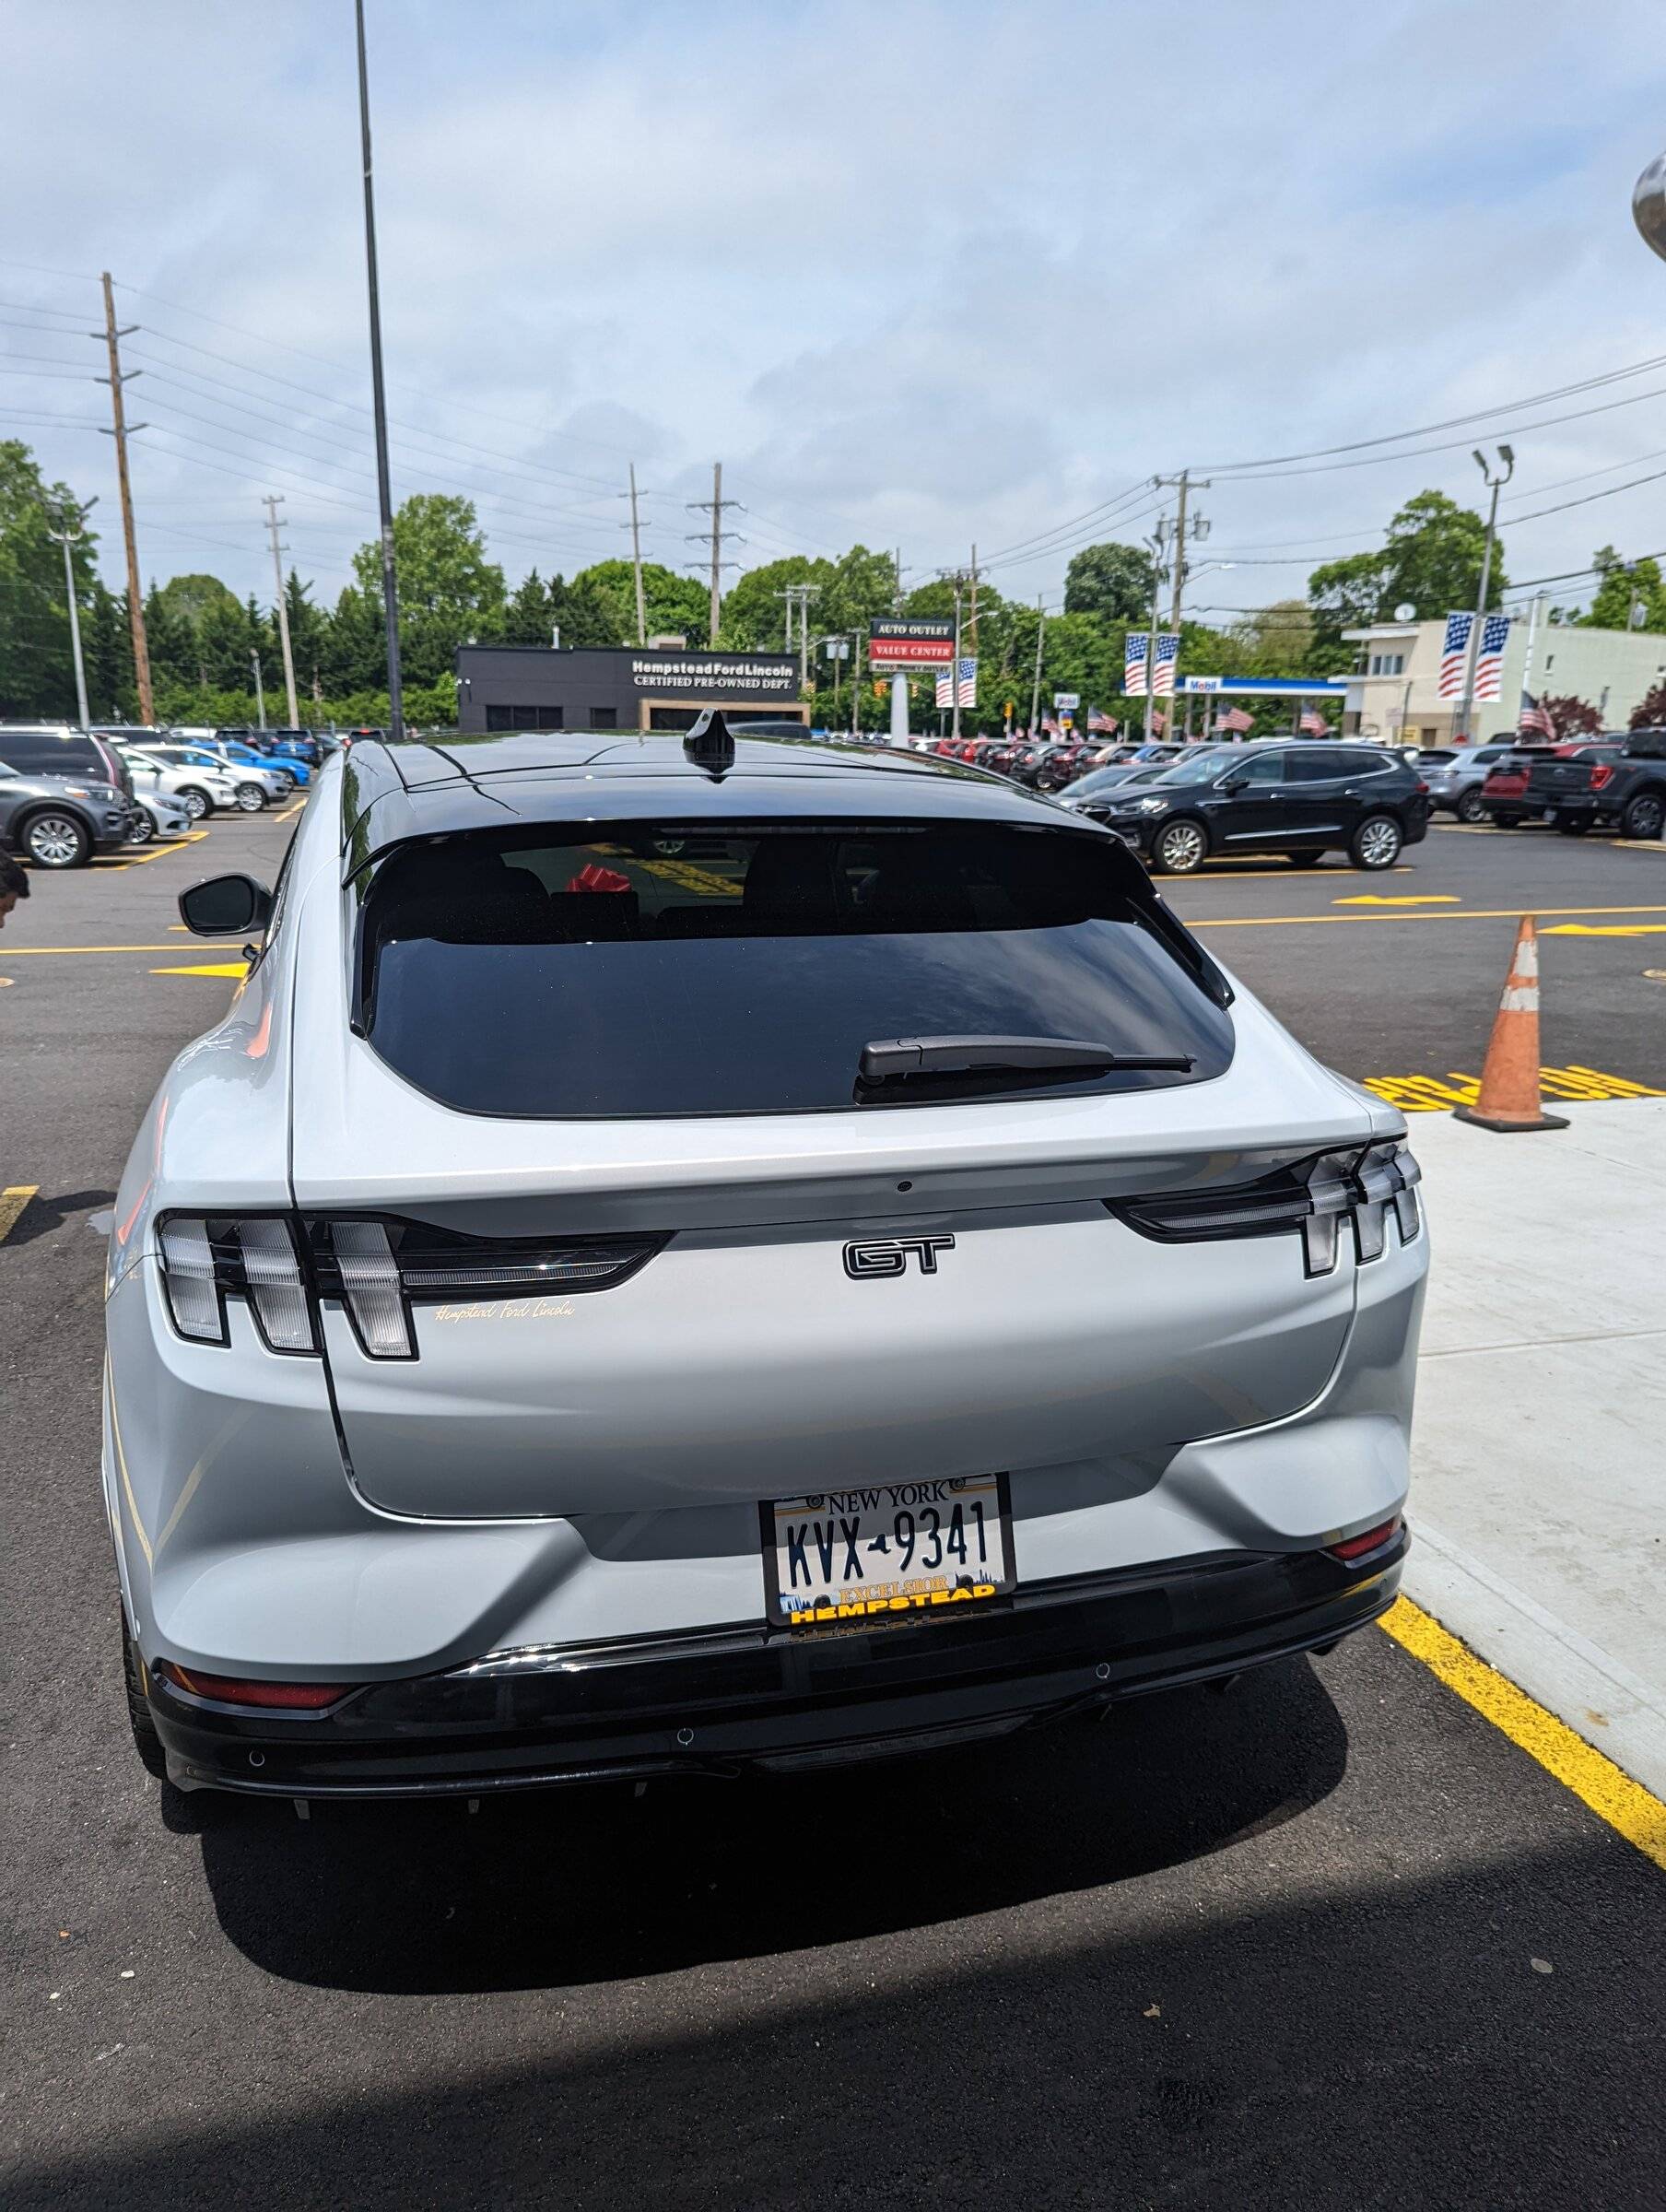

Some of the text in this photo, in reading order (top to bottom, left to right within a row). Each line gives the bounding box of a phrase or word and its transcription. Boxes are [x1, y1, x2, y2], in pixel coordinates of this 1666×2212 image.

[878, 624, 950, 636] AUTO OUTLET
[875, 646, 950, 657] VALUE CENTER
[632, 660, 793, 677] Hempstead Ford Lincoln
[633, 675, 792, 689] CERTIFIED PRE-OWNED DEPT.
[1190, 680, 1216, 691] Mobil
[842, 1233, 956, 1280] GT
[435, 1299, 576, 1324] Hempstead Ford Lincoln
[828, 1480, 950, 1515] NEW YORK
[787, 1500, 987, 1588] KVX 9341
[839, 1575, 950, 1605] EXCELSIOR
[791, 1584, 996, 1624] HEMPSTEAD
